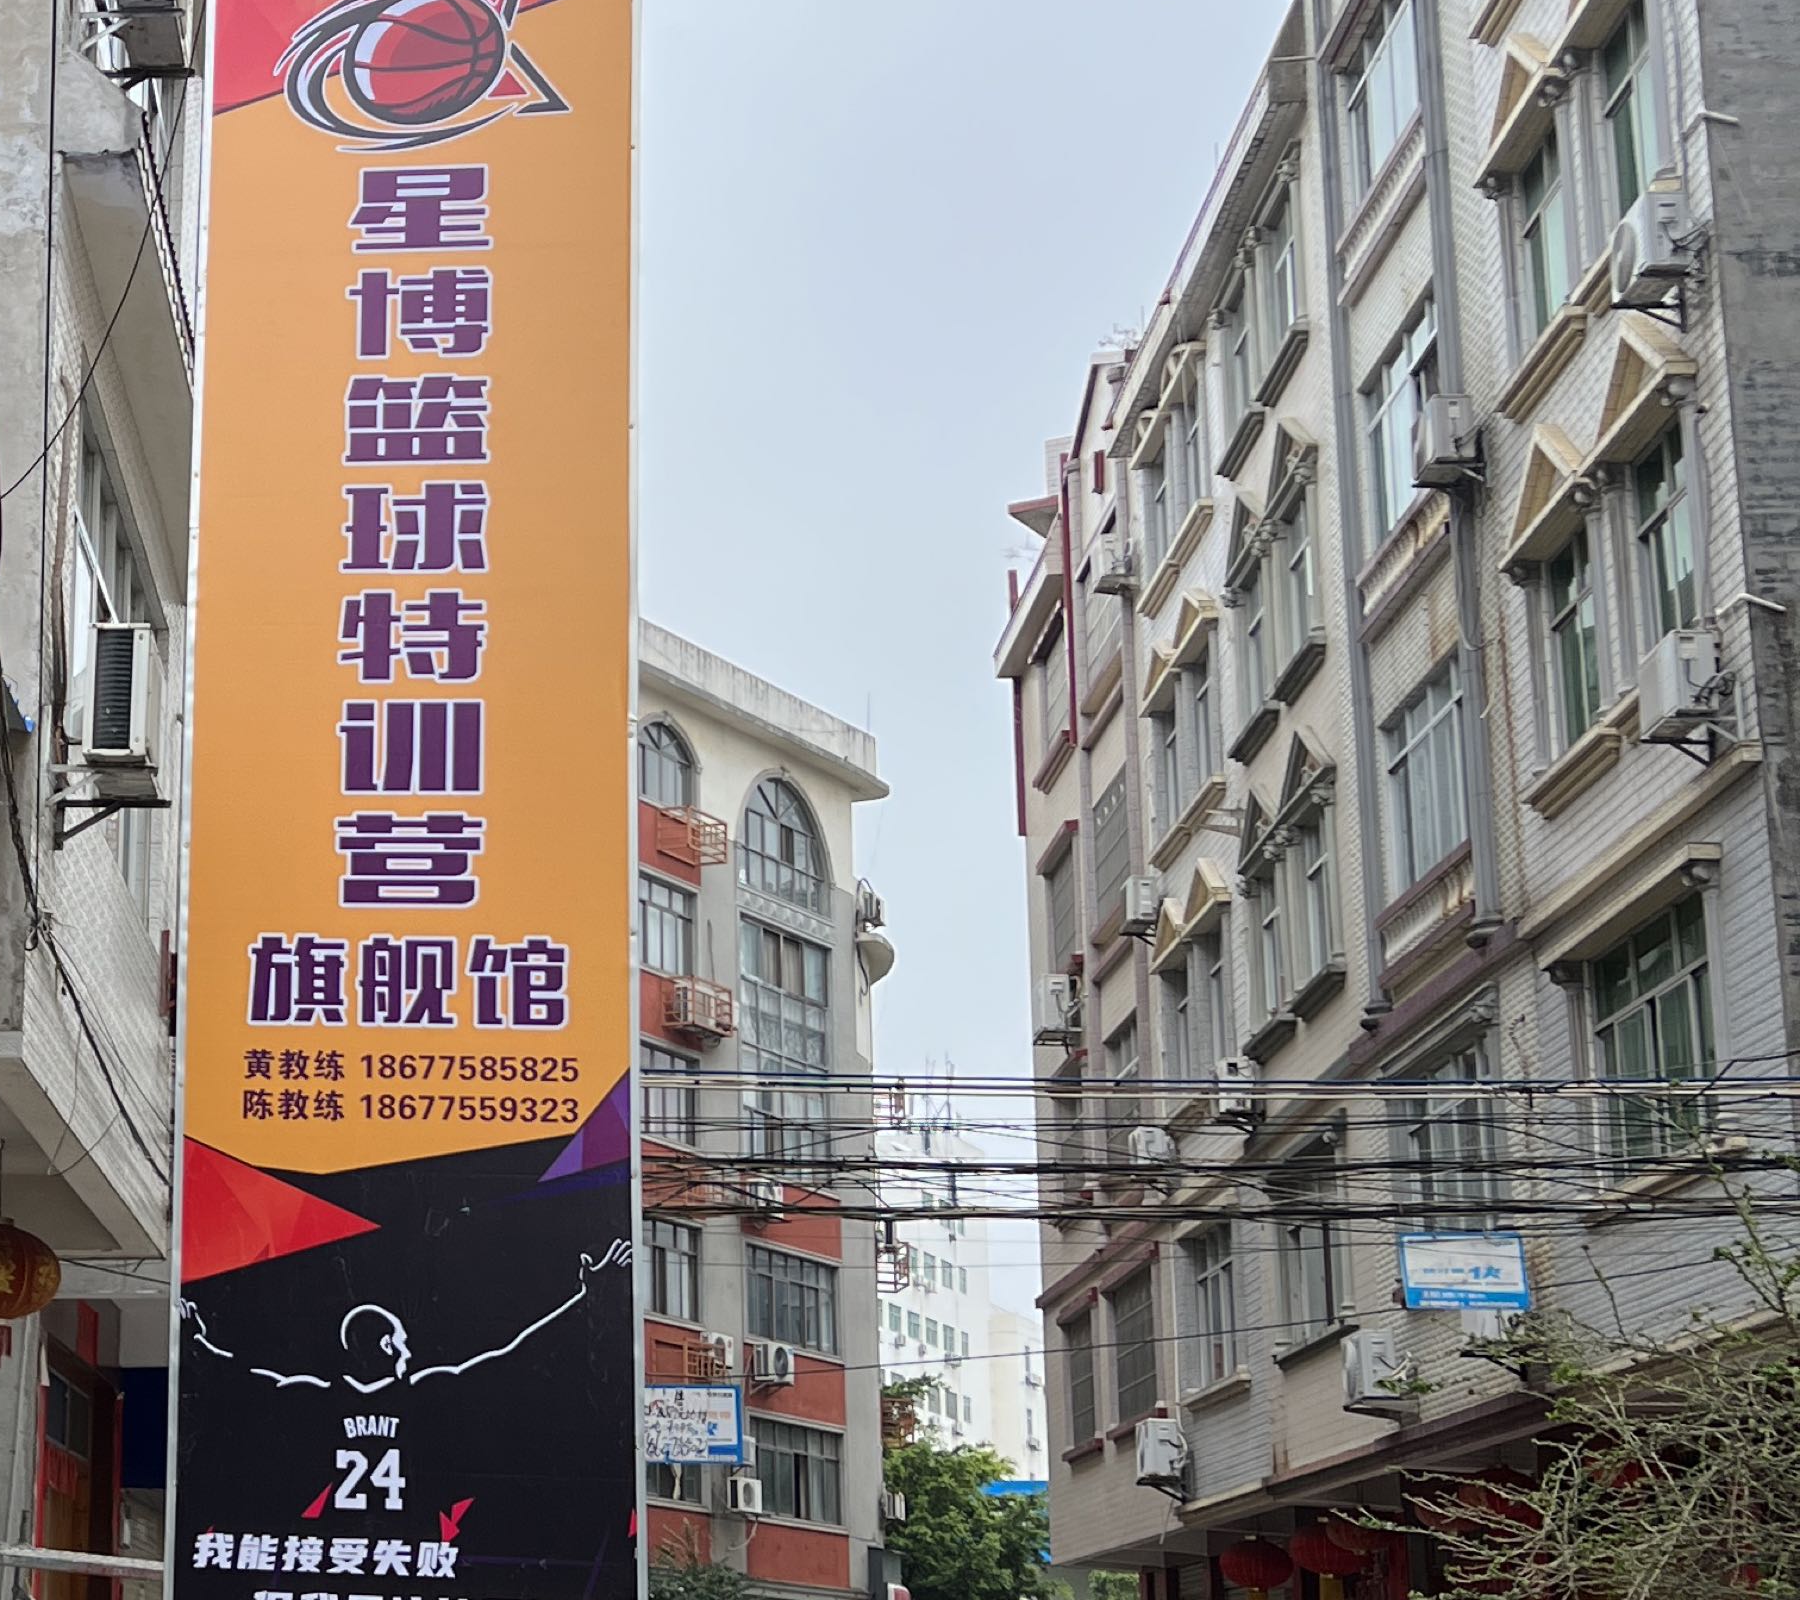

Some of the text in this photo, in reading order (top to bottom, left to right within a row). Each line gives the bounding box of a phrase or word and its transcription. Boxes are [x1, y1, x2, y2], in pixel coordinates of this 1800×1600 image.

[334, 164, 494, 907] 星博篮球特训营
[247, 932, 569, 1030] 旗舰馆
[243, 1048, 579, 1082] 黄教练 18677585825
[242, 1089, 579, 1123] 陈教练 18677559323
[343, 1415, 400, 1439] BRANT
[334, 1448, 406, 1510] 24
[193, 1532, 459, 1579] 我能接受失败
